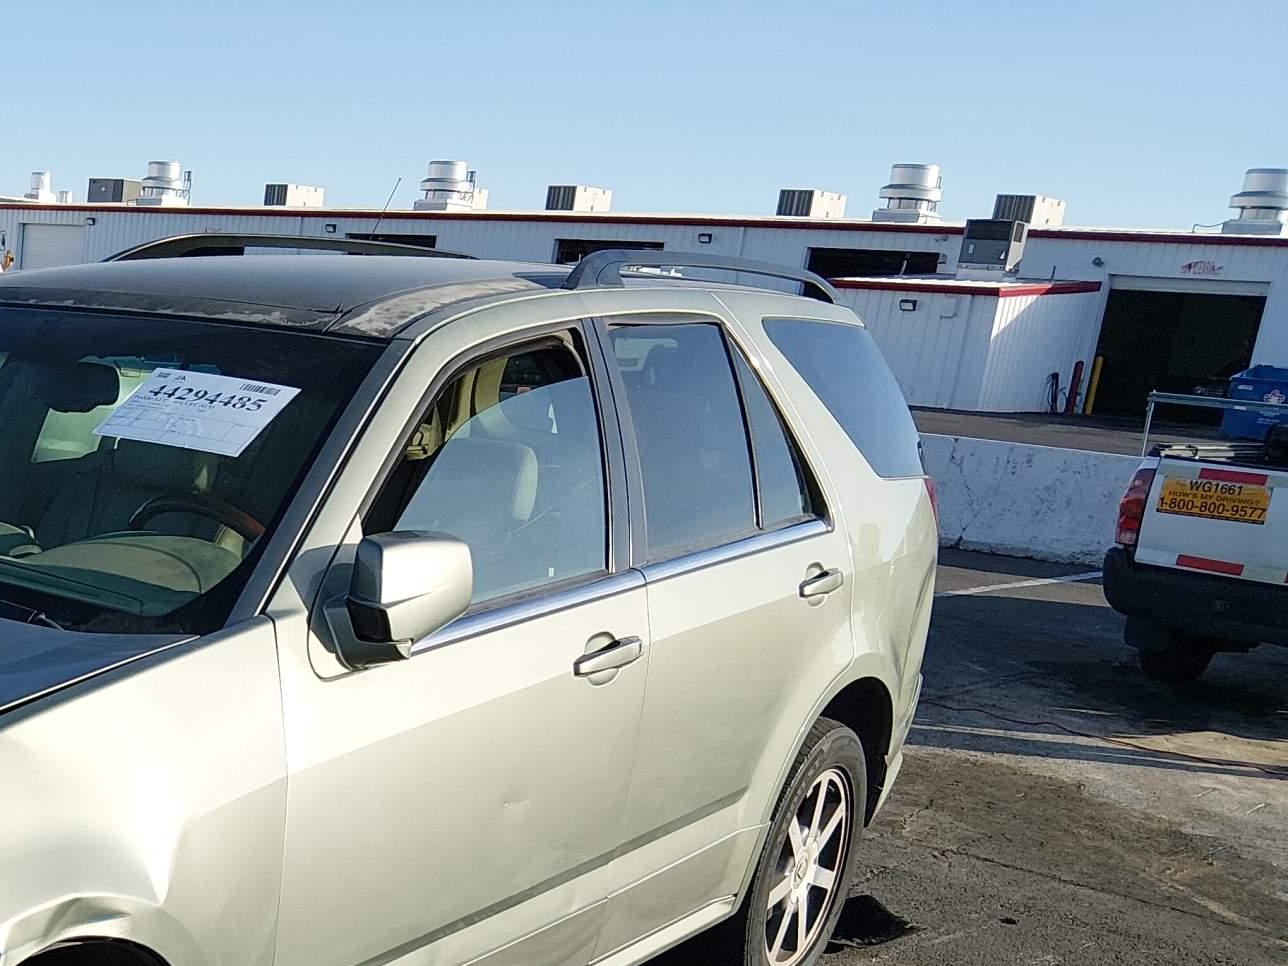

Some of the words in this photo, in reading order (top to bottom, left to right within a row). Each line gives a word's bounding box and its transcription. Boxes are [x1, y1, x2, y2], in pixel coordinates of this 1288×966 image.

[149, 384, 268, 412] 44294485
[1169, 490, 1198, 499] HOW'S
[1189, 480, 1244, 496] WG1661
[1160, 496, 1267, 519] 1-800-800-9577
